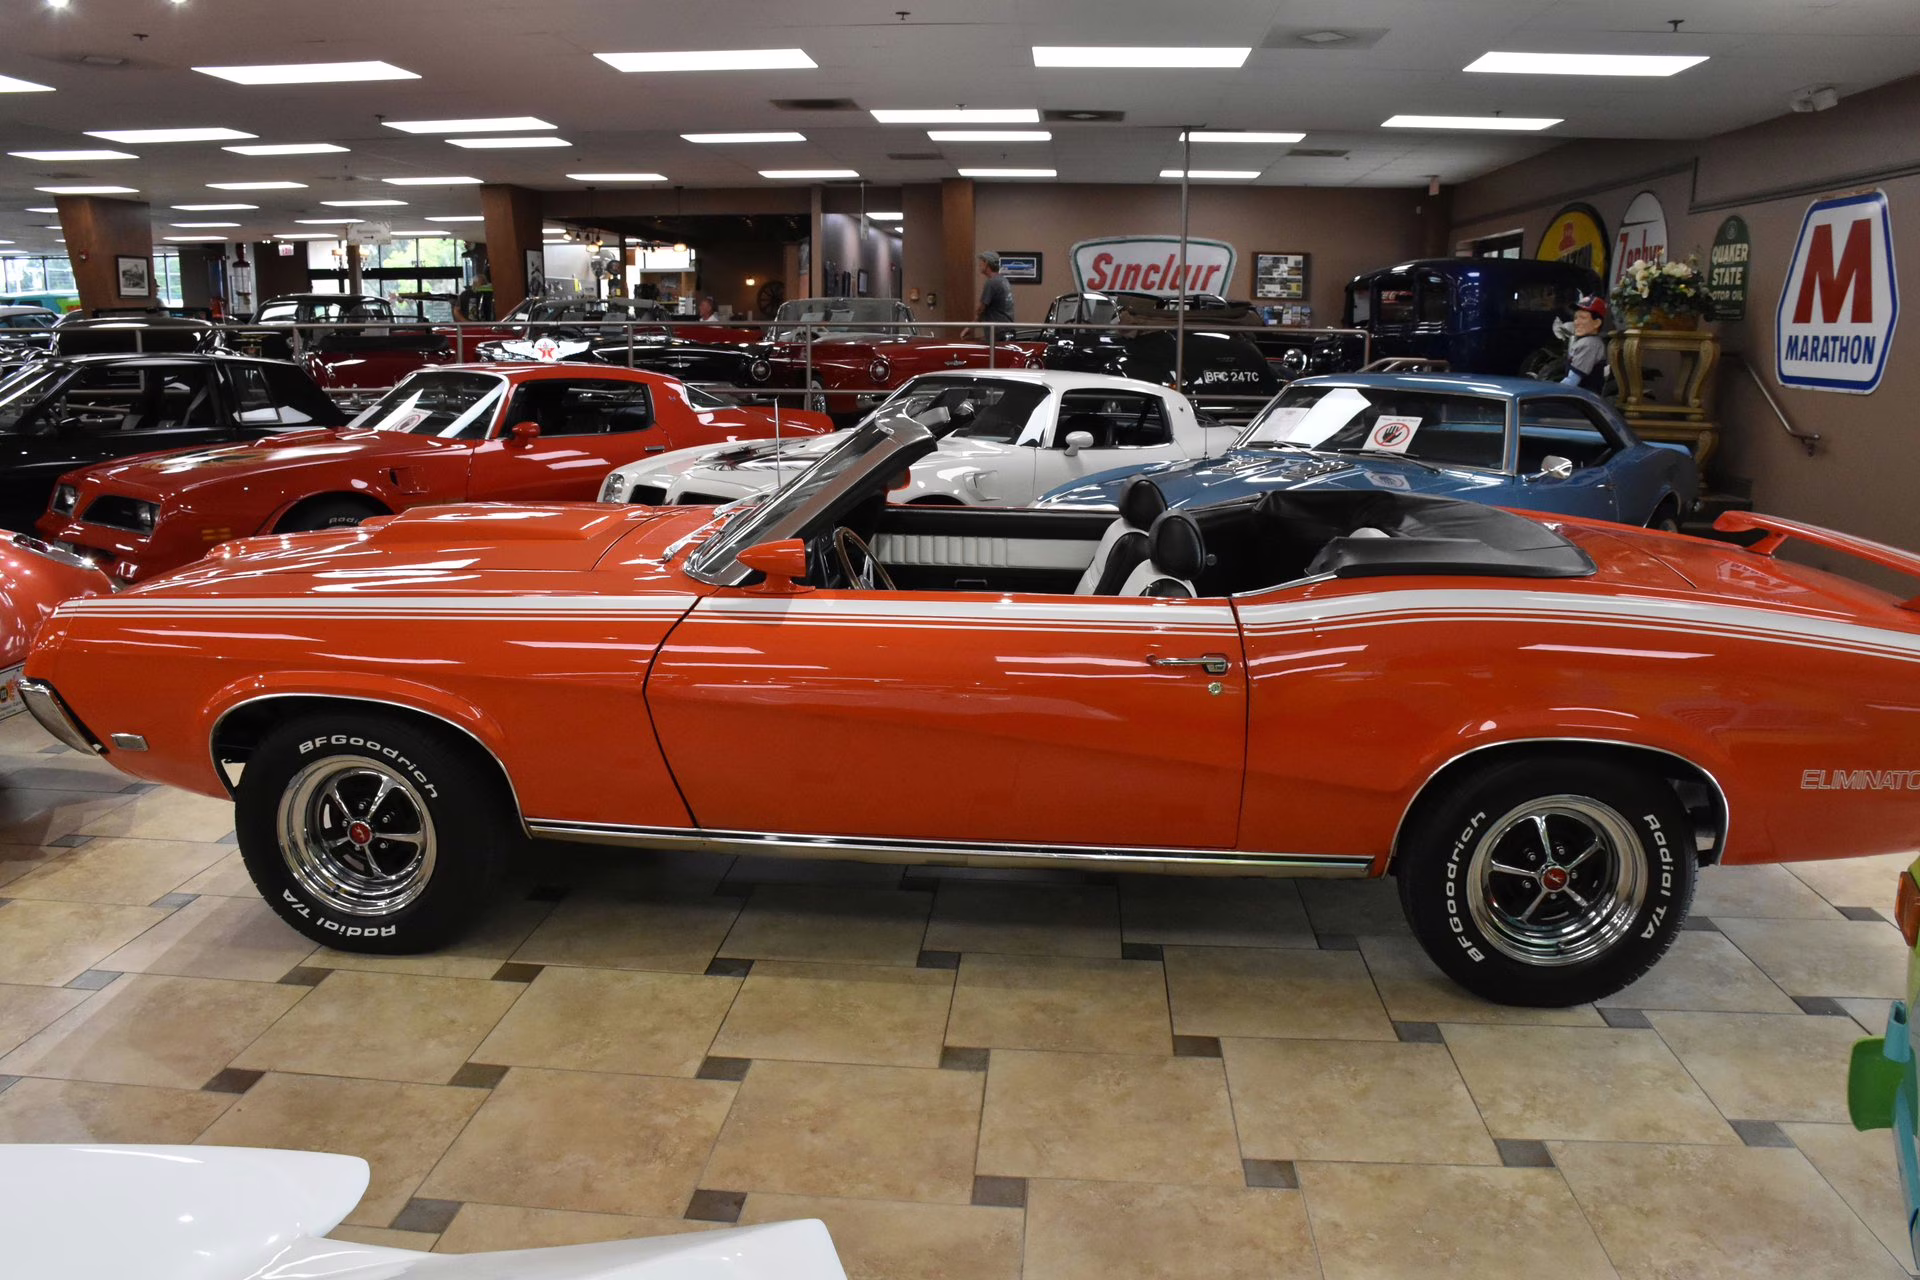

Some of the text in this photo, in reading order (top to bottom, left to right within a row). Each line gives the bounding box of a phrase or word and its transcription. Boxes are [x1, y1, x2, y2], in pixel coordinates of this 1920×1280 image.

[1087, 252, 1222, 291] Sinclair
[1712, 243, 1748, 266] QUAKER
[1792, 218, 1873, 324] M
[1709, 289, 1744, 301] OTOR OIL
[1712, 266, 1744, 286] STATE
[1785, 334, 1876, 364] MARATHON
[1230, 371, 1260, 382] 247C
[299, 735, 438, 798] BFGoodrich
[1445, 811, 1487, 963] BFGoodrich
[1640, 813, 1673, 939] Radial T/A
[282, 888, 397, 937] Radial T/A
